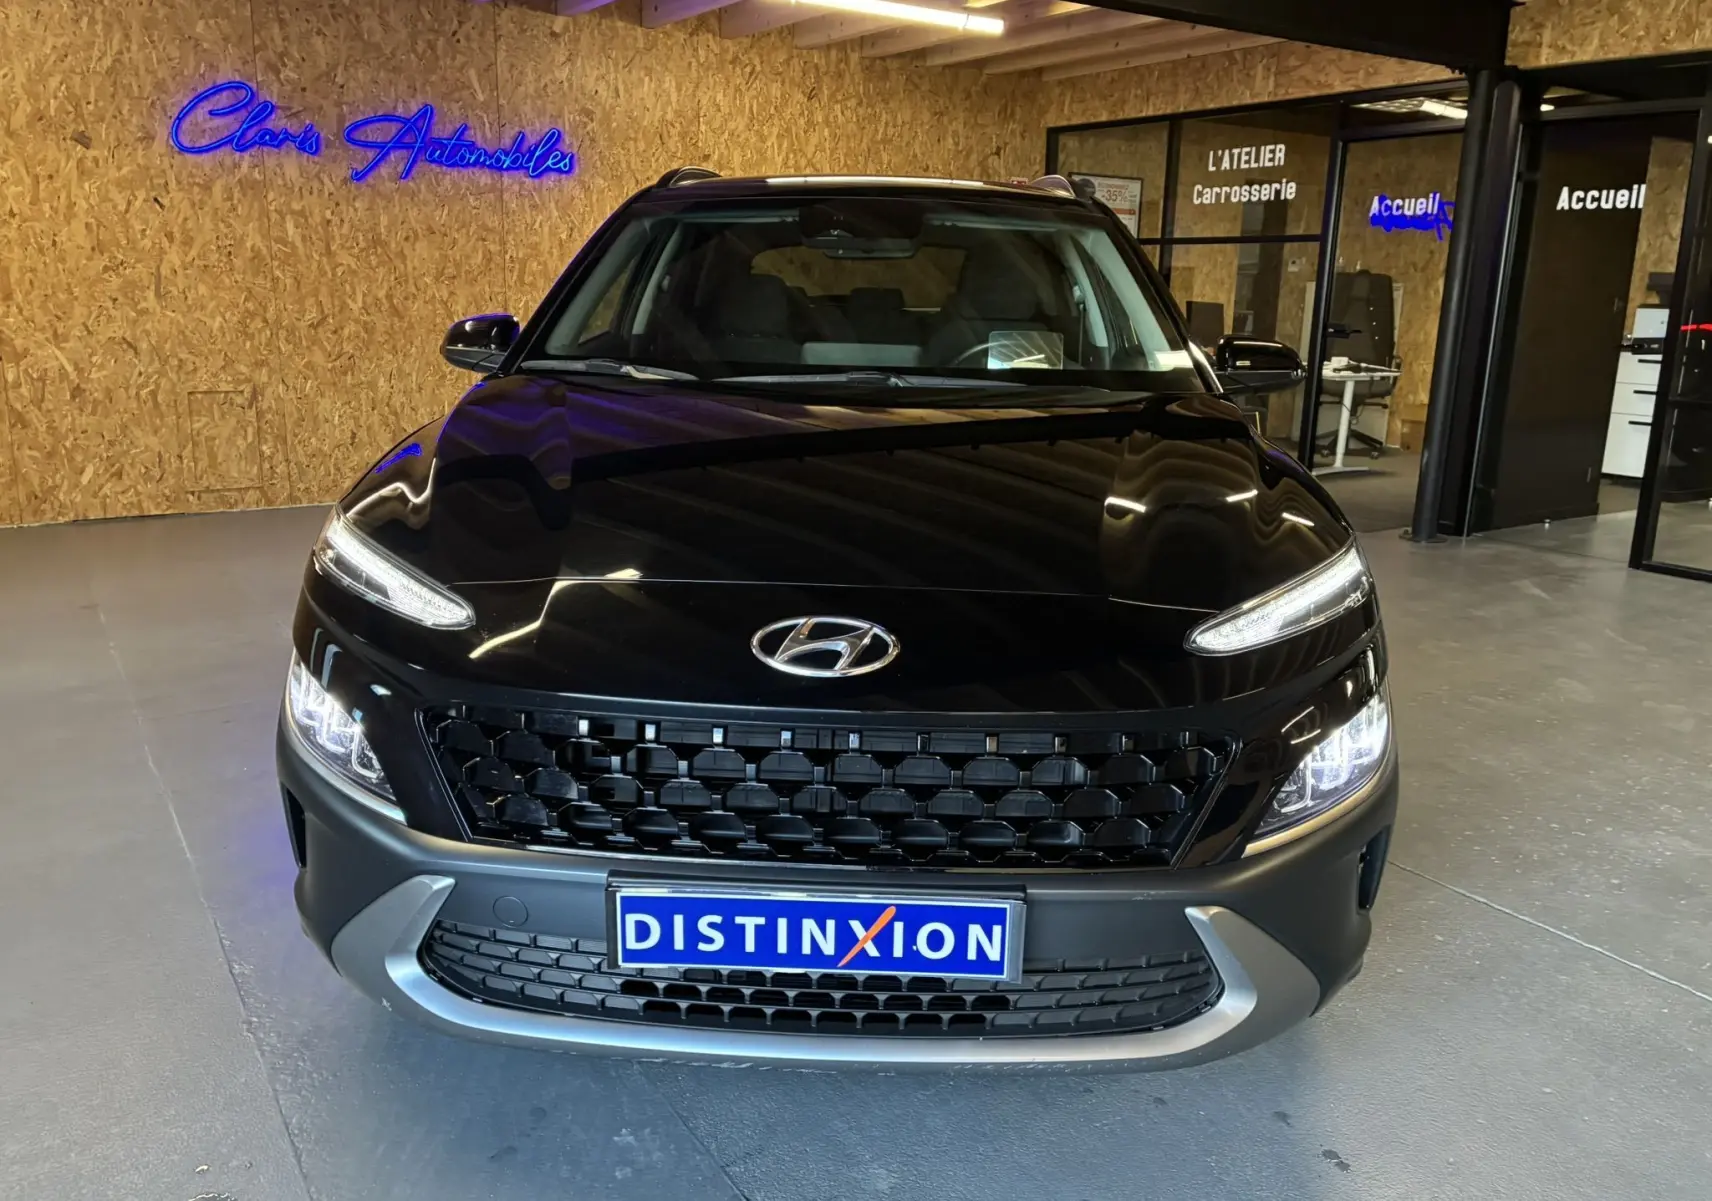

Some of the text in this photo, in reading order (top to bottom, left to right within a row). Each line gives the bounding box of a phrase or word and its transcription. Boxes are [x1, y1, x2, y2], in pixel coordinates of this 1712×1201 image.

[172, 80, 577, 181] Claris Automobiles
[1208, 143, 1286, 172] L'ATELIER
[1193, 178, 1298, 205] Carrosserie
[1369, 192, 1440, 217] Accueil
[1556, 184, 1647, 211] Accueil
[624, 905, 1002, 968] DISTINXION
